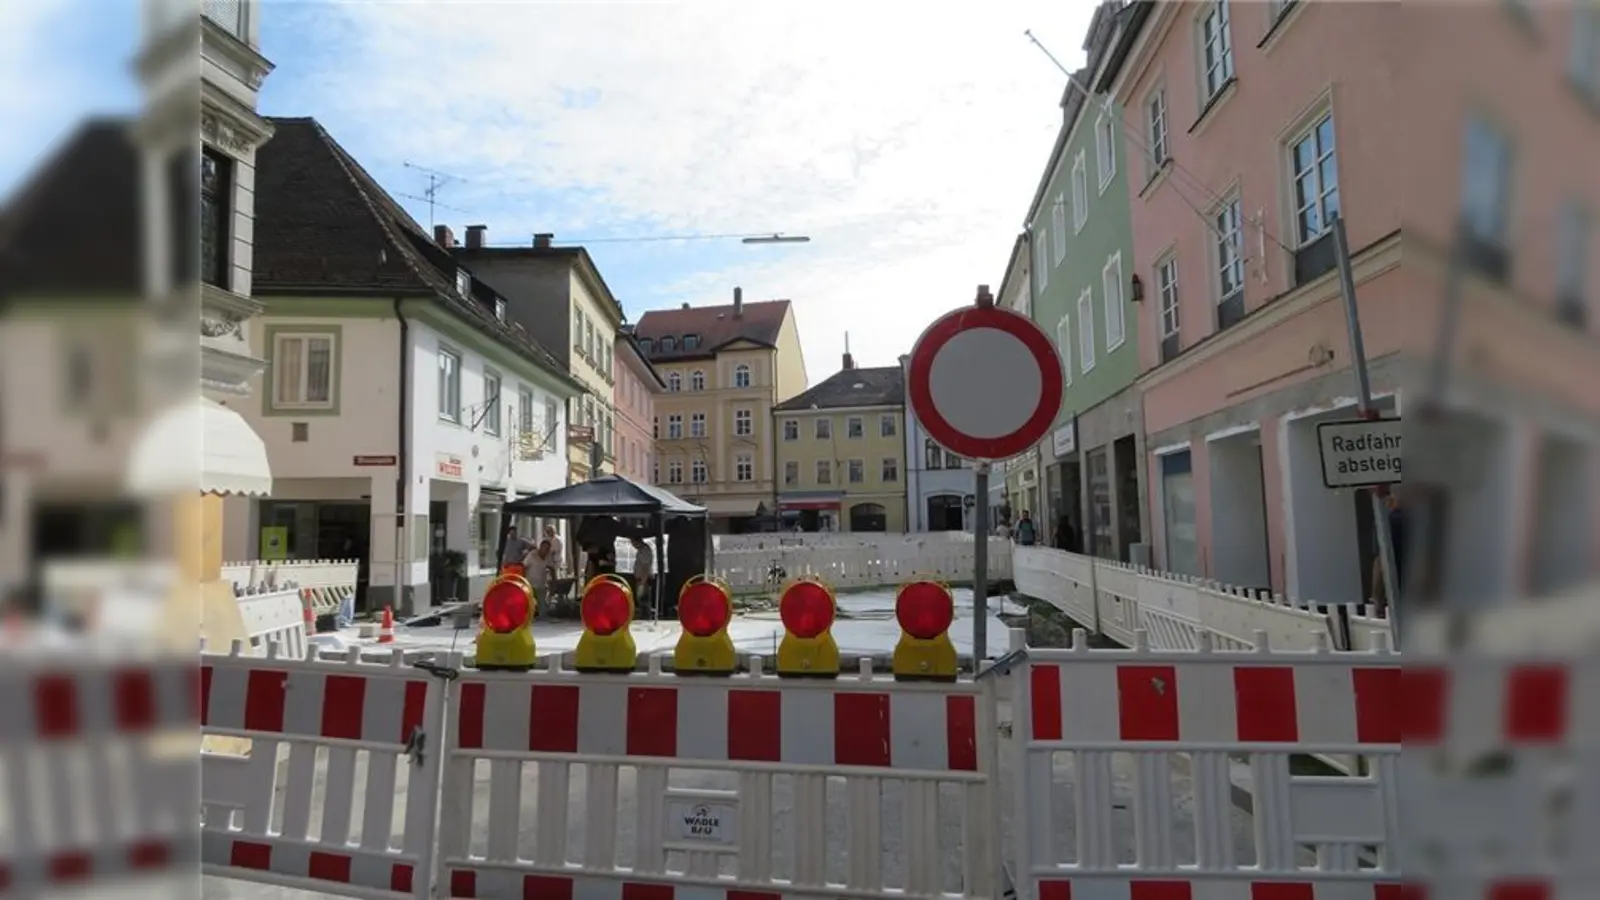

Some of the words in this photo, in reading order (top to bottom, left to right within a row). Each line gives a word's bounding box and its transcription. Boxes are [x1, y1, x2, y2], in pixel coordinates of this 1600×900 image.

[1332, 432, 1402, 453] Radfahr
[1338, 453, 1402, 474] absteig
[684, 816, 720, 828] WADLE
[691, 826, 713, 836] BAU
